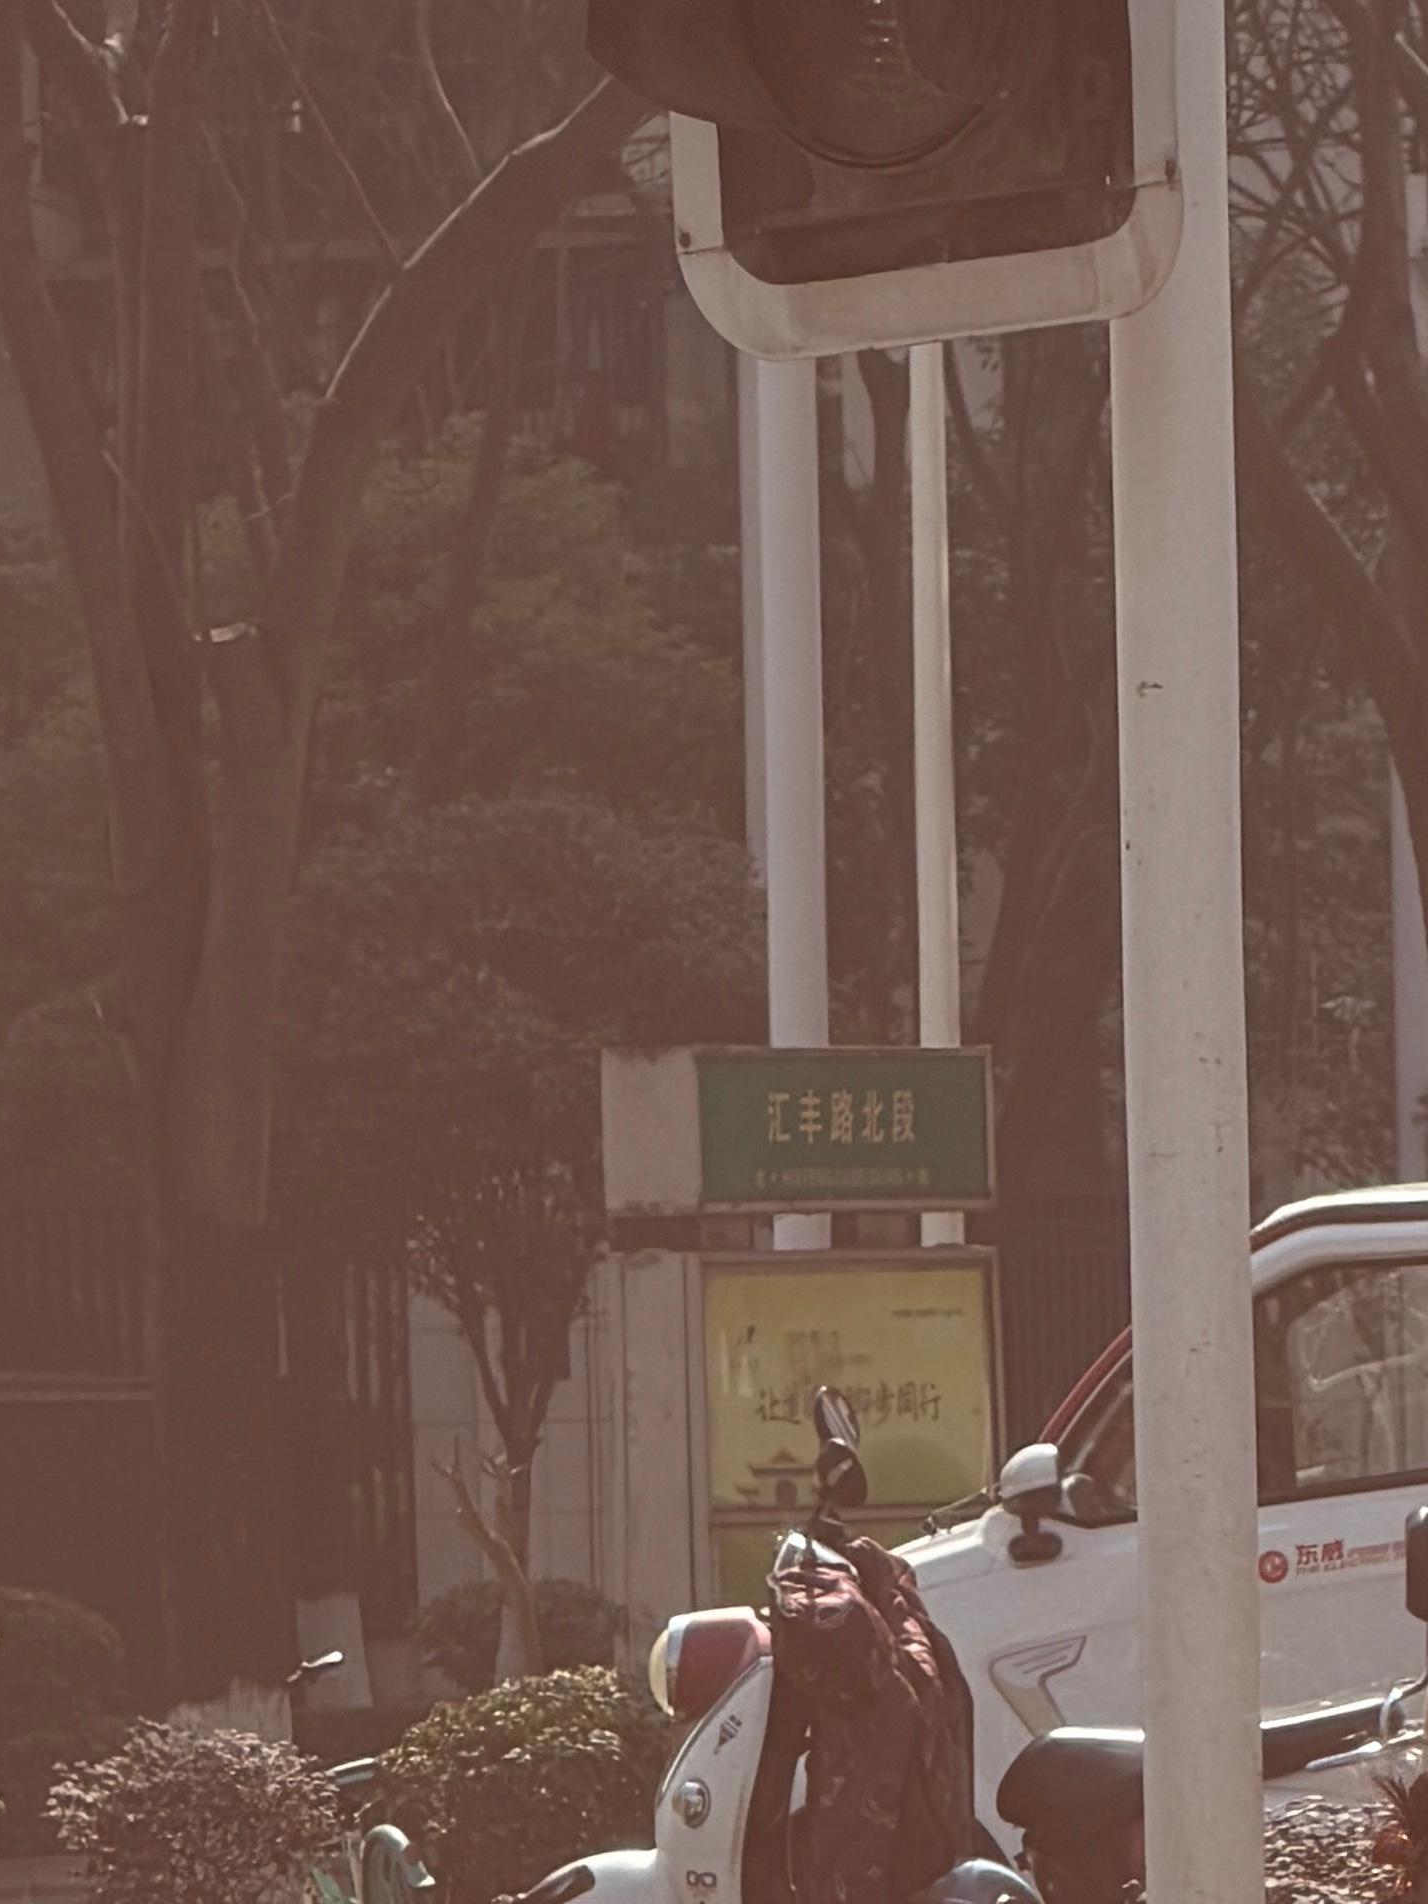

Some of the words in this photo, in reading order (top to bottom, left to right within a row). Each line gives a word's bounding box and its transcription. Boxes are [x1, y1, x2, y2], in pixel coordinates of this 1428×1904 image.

[767, 1089, 915, 1143] 汇丰路北段
